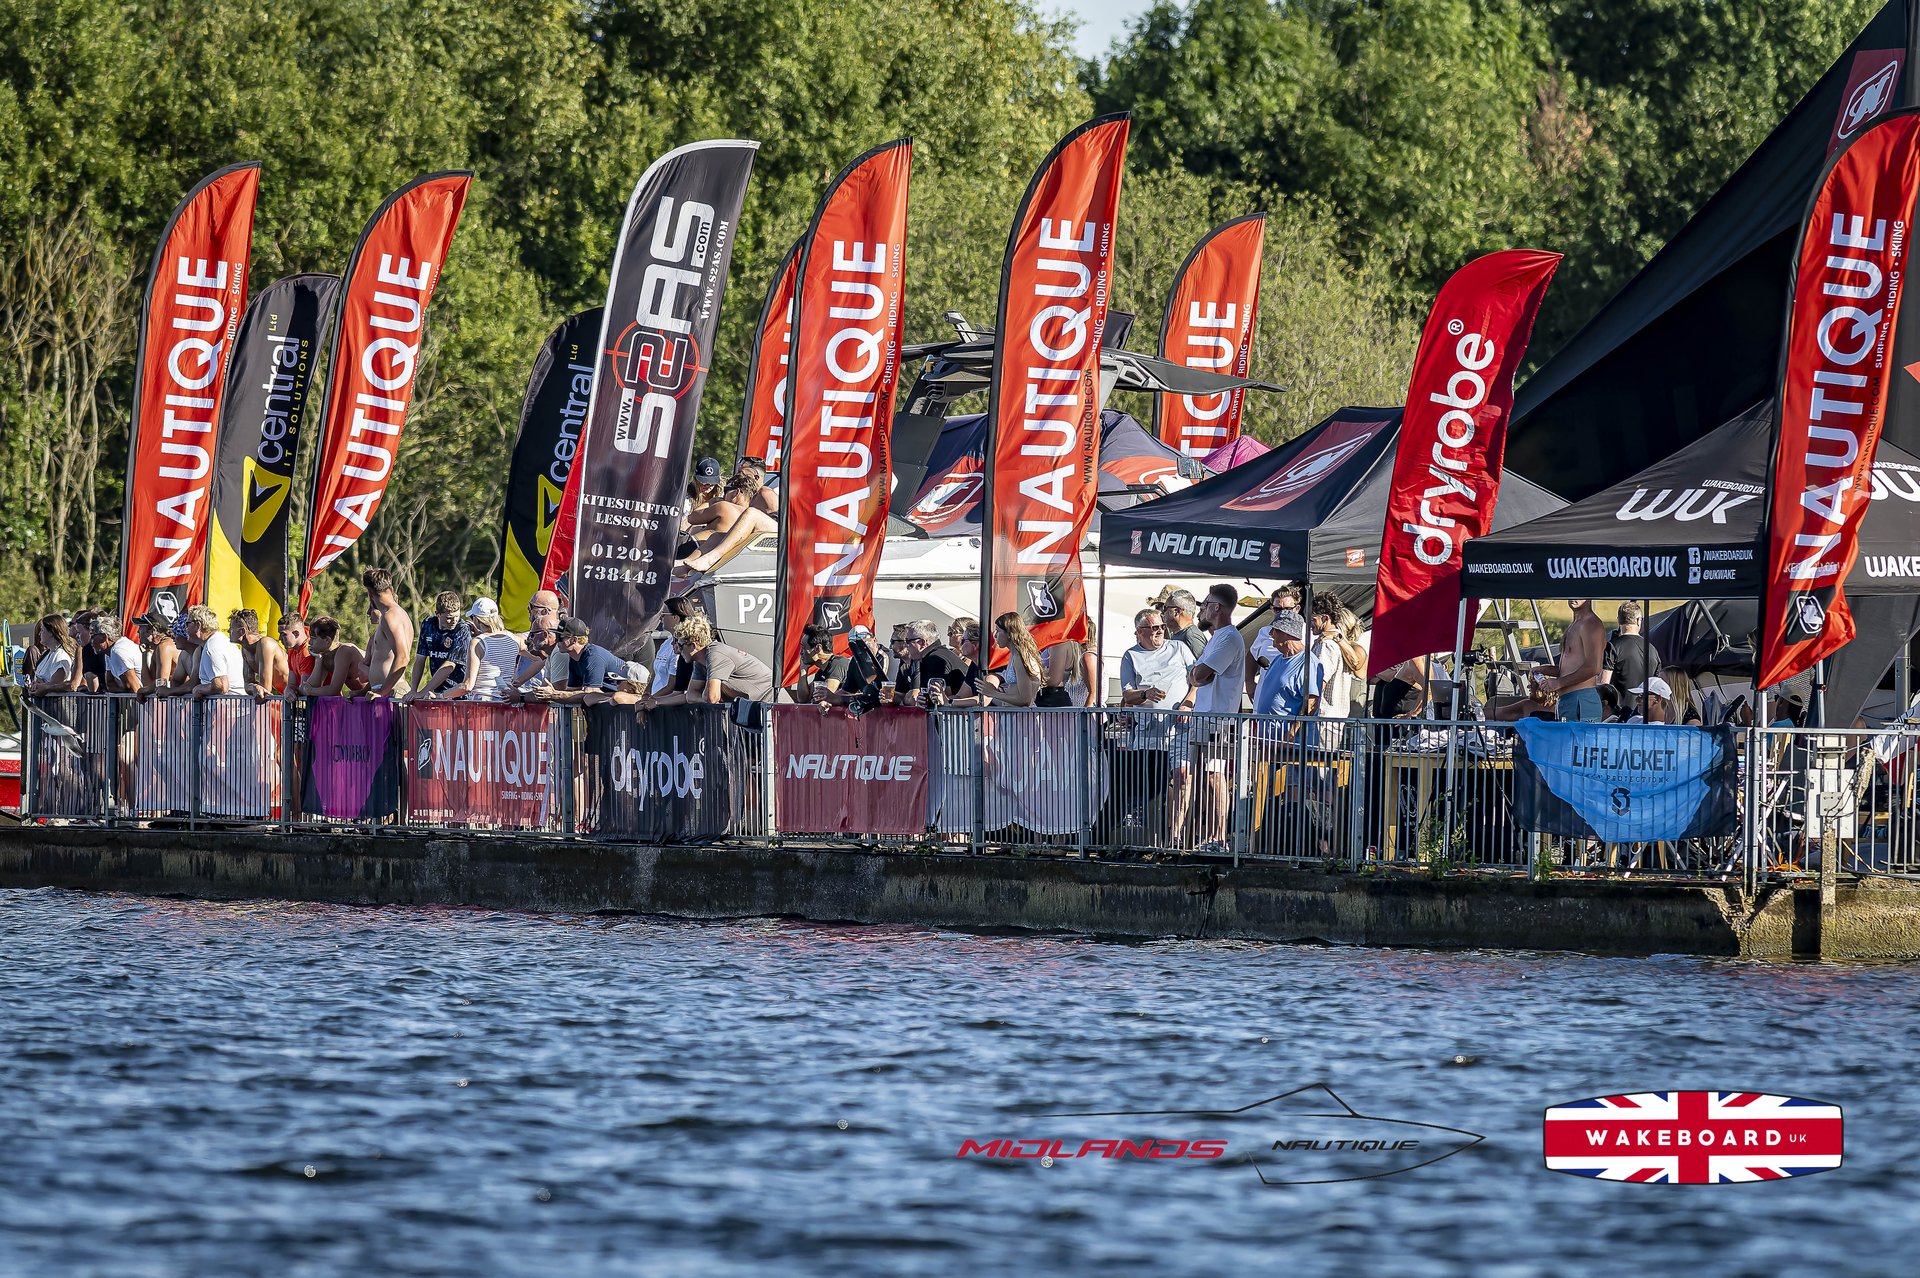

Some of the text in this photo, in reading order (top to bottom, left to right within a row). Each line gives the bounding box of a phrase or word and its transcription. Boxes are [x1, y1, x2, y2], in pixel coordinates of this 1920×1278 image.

[1100, 223, 1111, 257] SKIING
[1891, 220, 1904, 257] SKIING
[231, 263, 243, 295] SKIING
[700, 220, 730, 320] WWW.S2AS.COM
[1095, 270, 1107, 307] RIDING
[1887, 271, 1899, 309] RIDING
[227, 306, 238, 341] RIDING
[883, 243, 901, 384] SURFING RIDING SKIING
[1241, 303, 1251, 333] SKIING
[1239, 344, 1248, 374] RIDING
[258, 313, 300, 464] central Ltd
[284, 340, 309, 467] IT SOLUTIONS
[1016, 217, 1096, 566] NAUTIQUE
[1789, 212, 1887, 580] NAUTIQUE
[151, 256, 228, 578] NAUTIQUE
[550, 344, 594, 483] central Ltd
[616, 397, 632, 441] www.
[813, 240, 887, 587] NAUTIQUE
[1083, 368, 1093, 485] WWW.NAUTIQUE.COM
[1702, 480, 1754, 493] WAKEBOARD
[582, 494, 680, 517] KITESURFING
[595, 512, 659, 531] LESSONS
[1615, 488, 1759, 524] WUK
[591, 543, 654, 563] 01202
[1147, 531, 1262, 561] NAUTIQUE
[583, 565, 658, 585] 738448
[1468, 563, 1534, 574] WAKEBOARD.CO.UK
[1547, 556, 1677, 579] WAKEBOARD UK
[1703, 569, 1736, 581] @UKWAKE
[738, 593, 774, 625] P2
[435, 728, 547, 788] NAUTIQUE
[786, 754, 914, 784] NAUTIQUE
